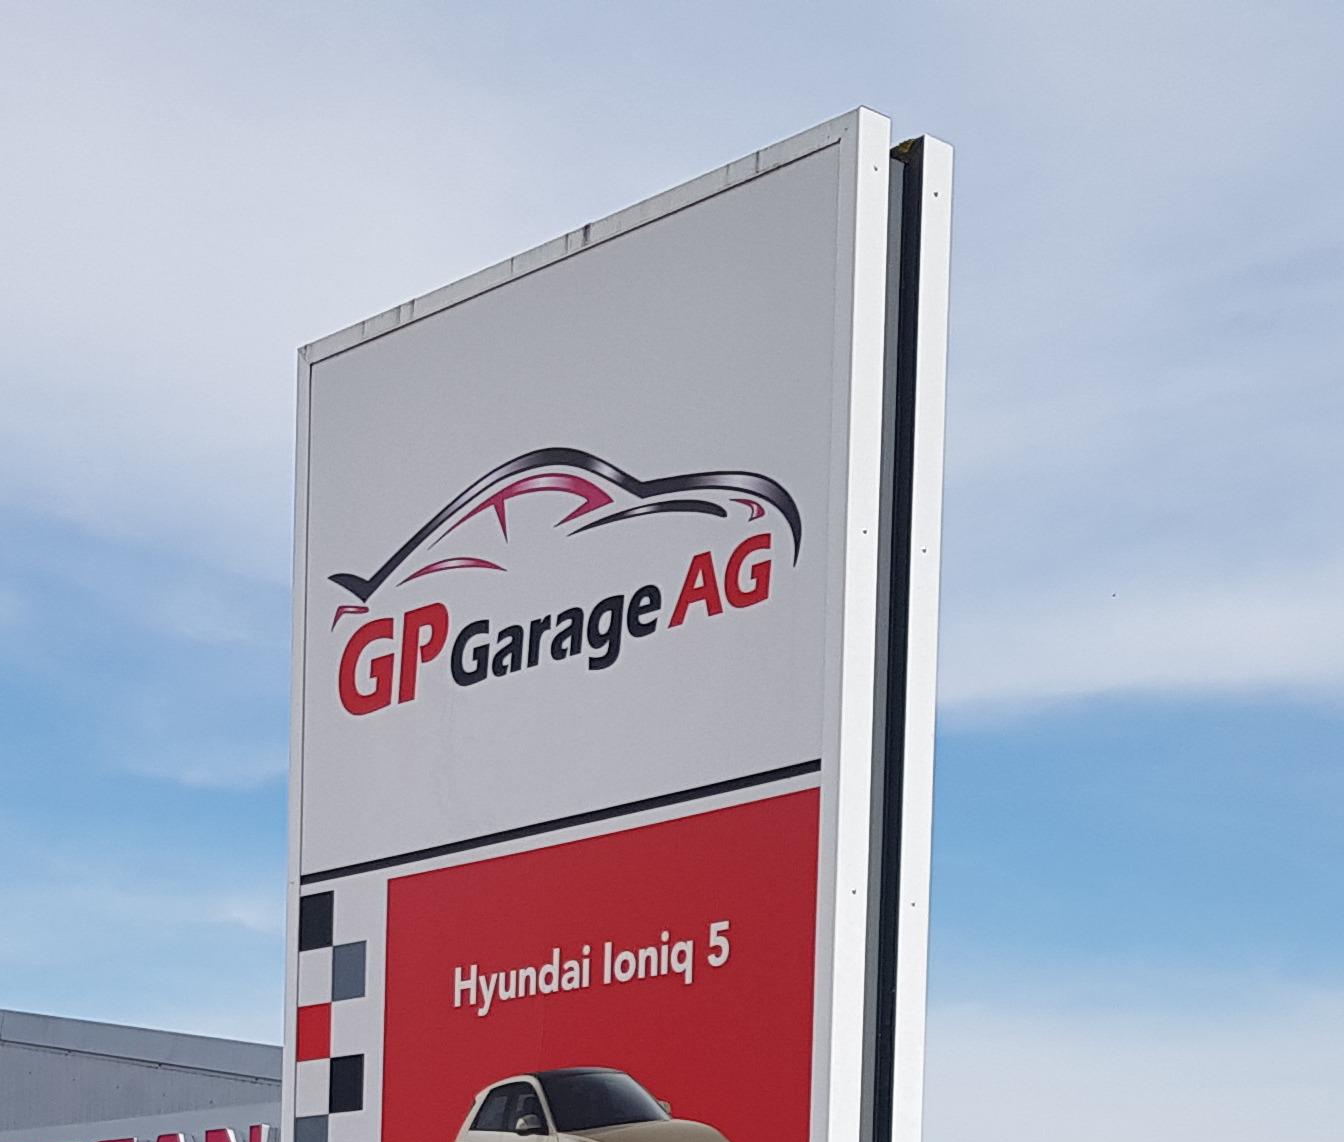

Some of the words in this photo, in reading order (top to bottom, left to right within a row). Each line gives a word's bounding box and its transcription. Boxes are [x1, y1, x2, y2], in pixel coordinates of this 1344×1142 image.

[338, 602, 449, 716] GP
[451, 584, 662, 686] Garage
[667, 533, 773, 628] AG
[452, 945, 591, 1017] Hyundai
[603, 930, 694, 985] Ioniq
[707, 920, 731, 967] 5
